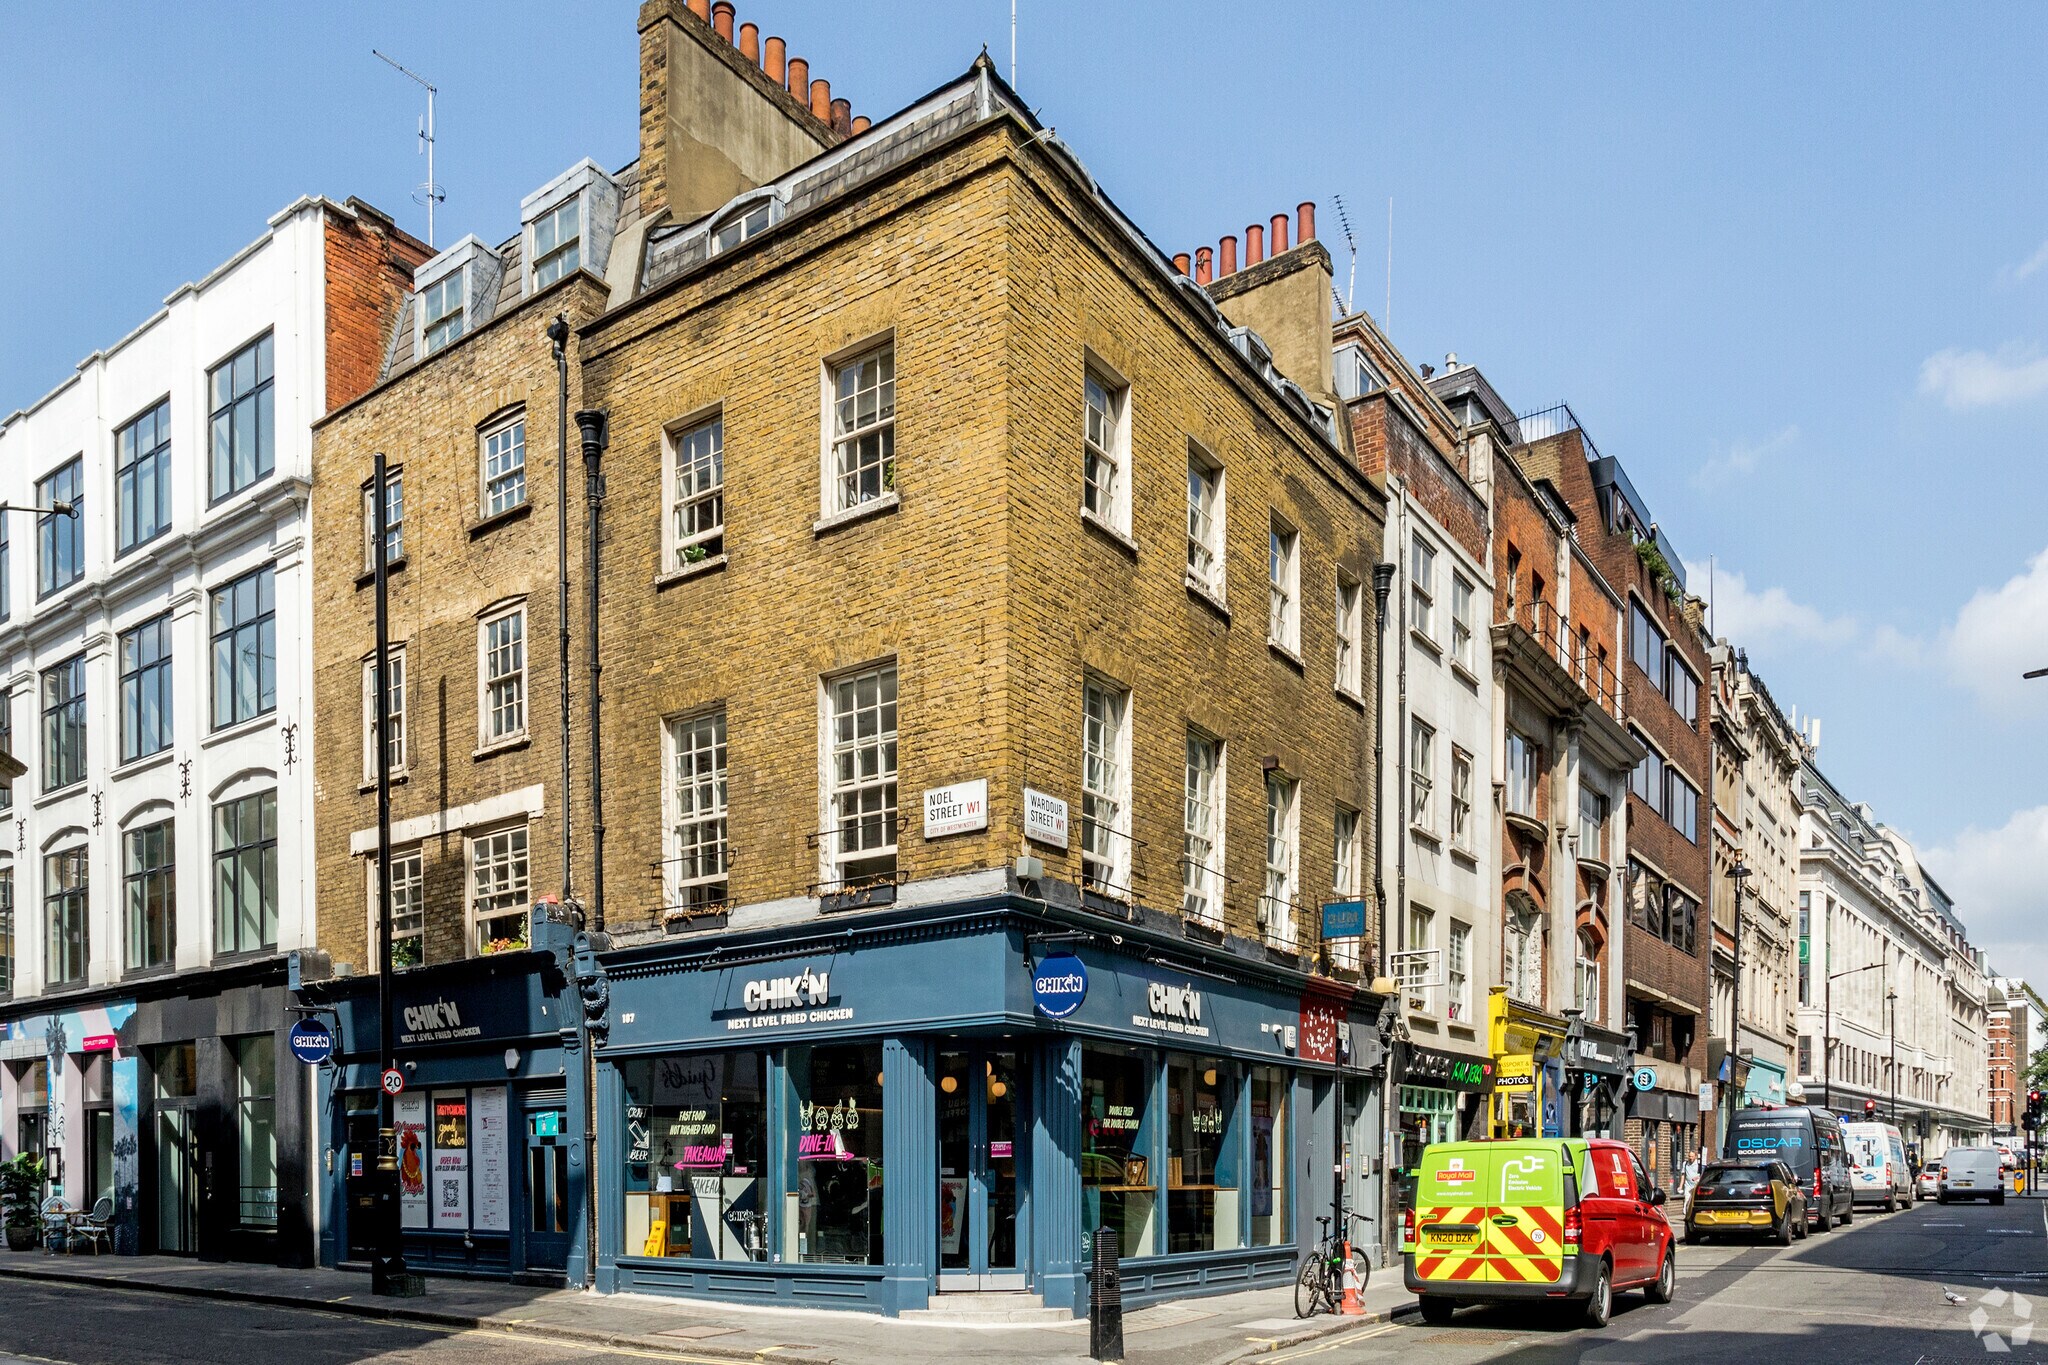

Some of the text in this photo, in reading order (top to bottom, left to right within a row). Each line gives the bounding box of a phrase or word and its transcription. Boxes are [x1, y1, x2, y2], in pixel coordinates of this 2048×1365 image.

[929, 791, 953, 807] NOEL
[1030, 794, 1063, 816] WARDOUR
[930, 801, 980, 821] STREET W1
[946, 820, 977, 832] WESTMINSTER
[1030, 810, 1064, 832] STREET W1
[743, 966, 829, 1012] CHIK'N
[1036, 973, 1083, 994] CHIK'N
[1149, 982, 1200, 1020] CHIK'N
[403, 996, 461, 1032] CHIK'N
[728, 1008, 854, 1030] NEXT LEVEL FRIED CHICKEN
[400, 1026, 481, 1044] NEXT LEVEL FRIED CHICKEN
[1132, 1015, 1209, 1038] NEXT LEVEL FRIED CHICKEN
[293, 1034, 330, 1048] CHIK'N
[386, 1076, 402, 1088] 20
[1497, 1076, 1529, 1085] PHOTOS
[627, 1106, 648, 1118] CRAFT
[678, 1110, 706, 1122] FAST FOOD
[438, 1118, 456, 1144] good
[670, 1124, 716, 1136] NOT RUSHED FOOD
[446, 1132, 464, 1146] vibes
[799, 1134, 836, 1152] DINE-IN
[1738, 1137, 1802, 1149] OSCAR
[630, 1149, 648, 1160] BEER
[683, 1144, 727, 1163] TAKEAWAY
[1438, 1172, 1458, 1180] Royal
[1430, 1233, 1473, 1242] KN20 DZK
